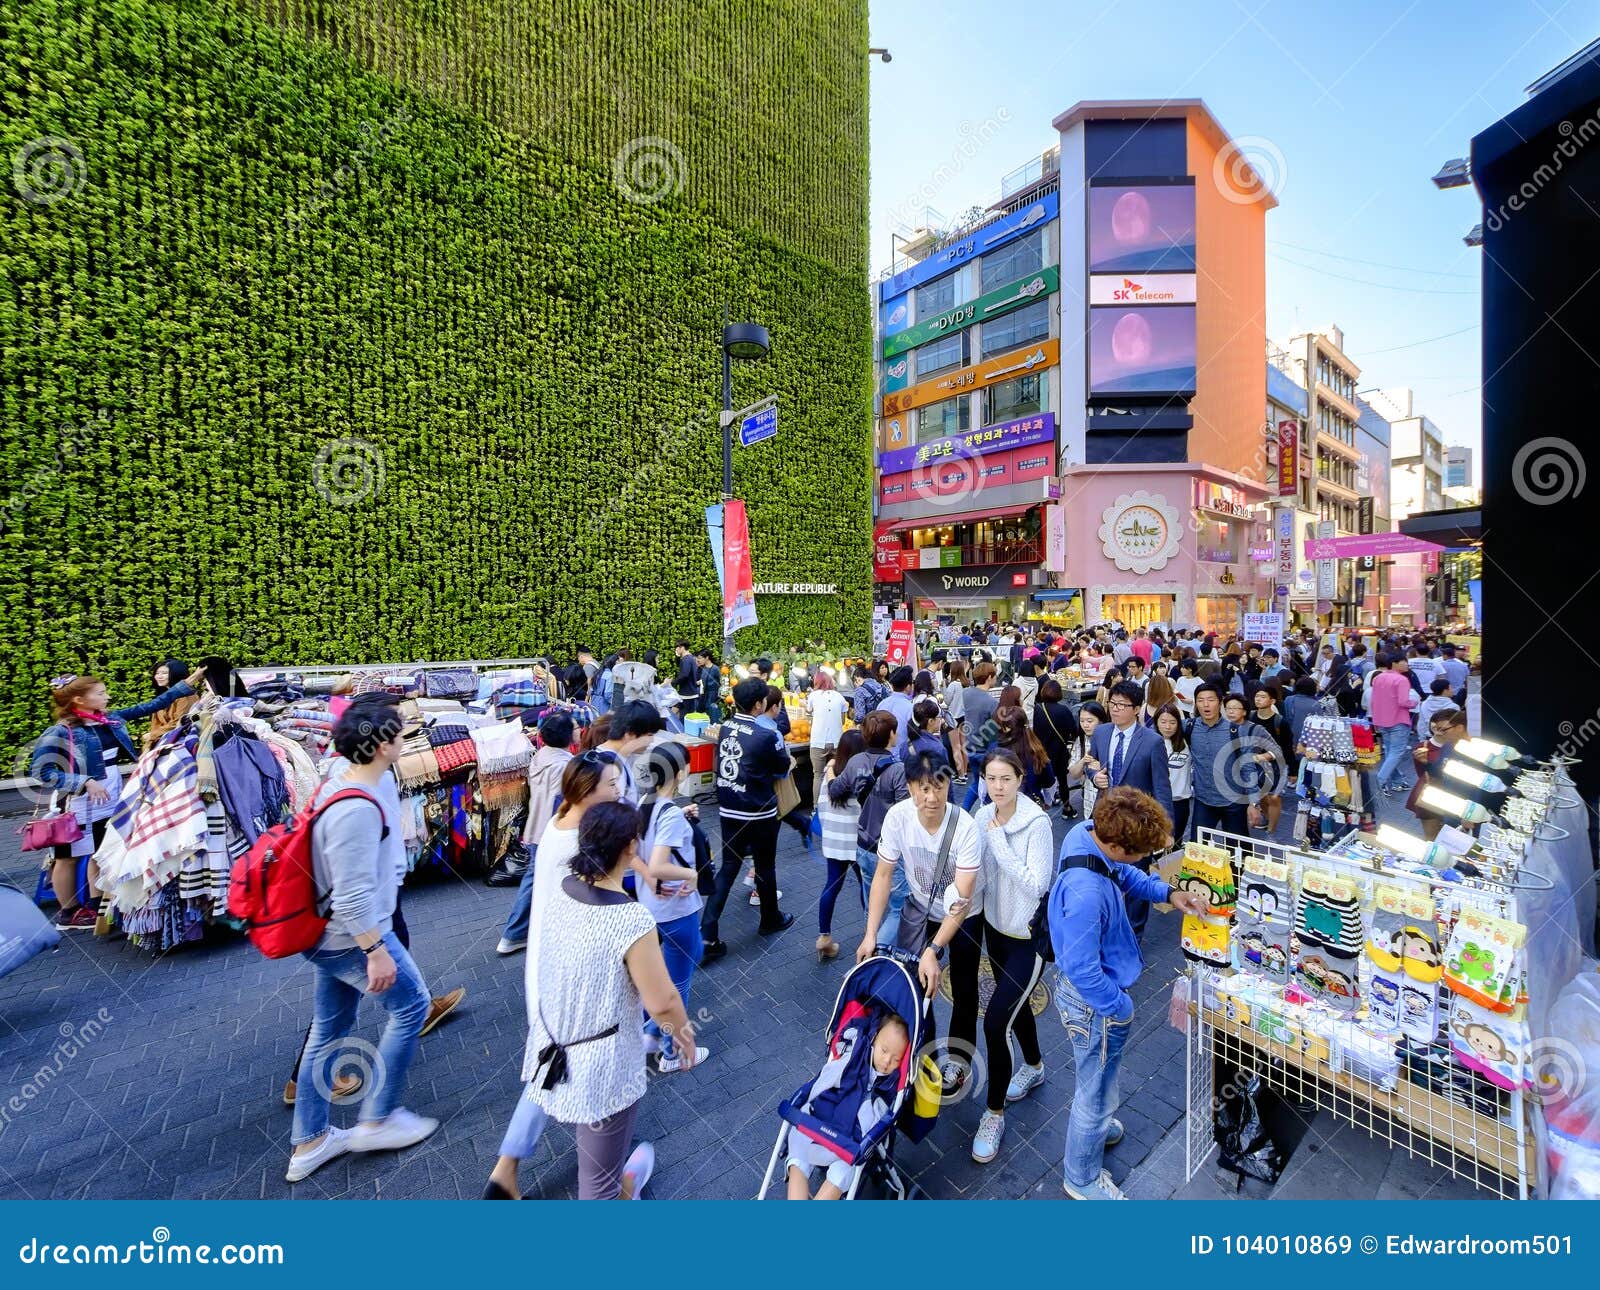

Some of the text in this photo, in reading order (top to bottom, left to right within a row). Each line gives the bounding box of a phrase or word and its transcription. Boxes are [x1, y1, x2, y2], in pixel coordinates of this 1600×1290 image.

[1113, 290, 1174, 300] SK telecom
[939, 305, 975, 330] DVD방
[955, 576, 989, 587] WORLD
[752, 583, 837, 594] NATURE REPUBLIC
